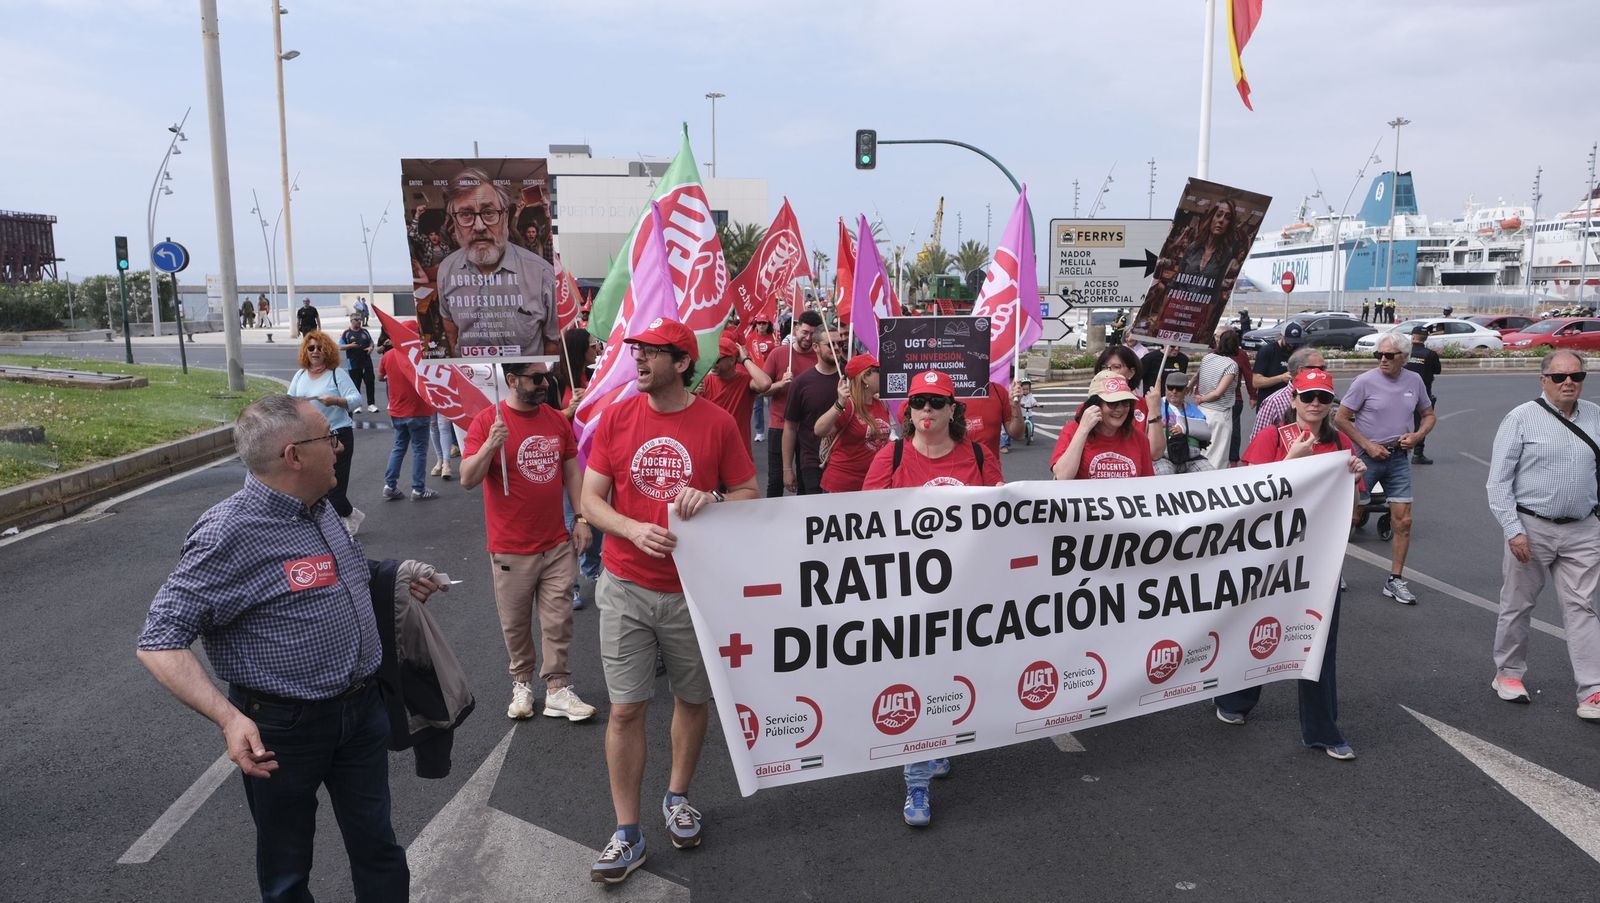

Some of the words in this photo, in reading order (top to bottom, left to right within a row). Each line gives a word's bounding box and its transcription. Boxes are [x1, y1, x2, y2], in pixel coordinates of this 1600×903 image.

[1077, 231, 1124, 241] FERRYS
[1059, 267, 1093, 275] ARGELIA
[451, 272, 502, 286] AGRESIÓN
[507, 273, 519, 286] AL
[1177, 272, 1206, 286] AGRESIÓN
[1208, 279, 1216, 288] AL
[449, 294, 523, 307] PROFESORADO
[1168, 288, 1212, 304] PROFESORADO
[905, 338, 927, 348] UGT
[462, 346, 486, 356] UGT
[905, 353, 918, 361] SIN
[903, 362, 913, 370] NO
[930, 360, 966, 369] INCLUSIÓN.
[642, 457, 682, 469] DOCENTES
[641, 468, 681, 478] ESENCIALES
[632, 473, 660, 499] DIGNIDAD
[661, 479, 689, 499] LABORAL
[806, 511, 886, 545] PARA
[894, 505, 963, 540] L@S
[972, 497, 1115, 530] DOCENTES
[1115, 495, 1152, 519] DE
[1156, 474, 1294, 517] ANDALUCÍA
[1051, 507, 1307, 576] BUROCRACIA
[316, 561, 331, 570] UGT
[800, 548, 953, 608] RATIO
[773, 577, 1125, 673] DIGNIFICACIÓN
[1137, 555, 1310, 619] SALARIAL
[1253, 622, 1278, 641] UGT
[1285, 623, 1315, 633] Servicios
[1284, 631, 1312, 643] Públicos
[1150, 645, 1180, 664] UGT
[1186, 643, 1211, 657] Servicios
[1183, 652, 1208, 667] Públicos
[1063, 667, 1096, 680] Servicios
[1266, 661, 1299, 673] Andalucía
[1024, 667, 1055, 686] UGT
[1063, 678, 1094, 691] Públicos
[1163, 684, 1197, 698] Andalucía
[879, 691, 915, 711] UGT
[926, 692, 964, 704] Servicios
[926, 703, 961, 716] Públicos
[766, 713, 808, 725] Servicios
[1044, 711, 1083, 727] Andalucía
[766, 724, 805, 737] Públicos
[903, 737, 947, 752] Andalucía
[755, 763, 791, 776] dalucía
